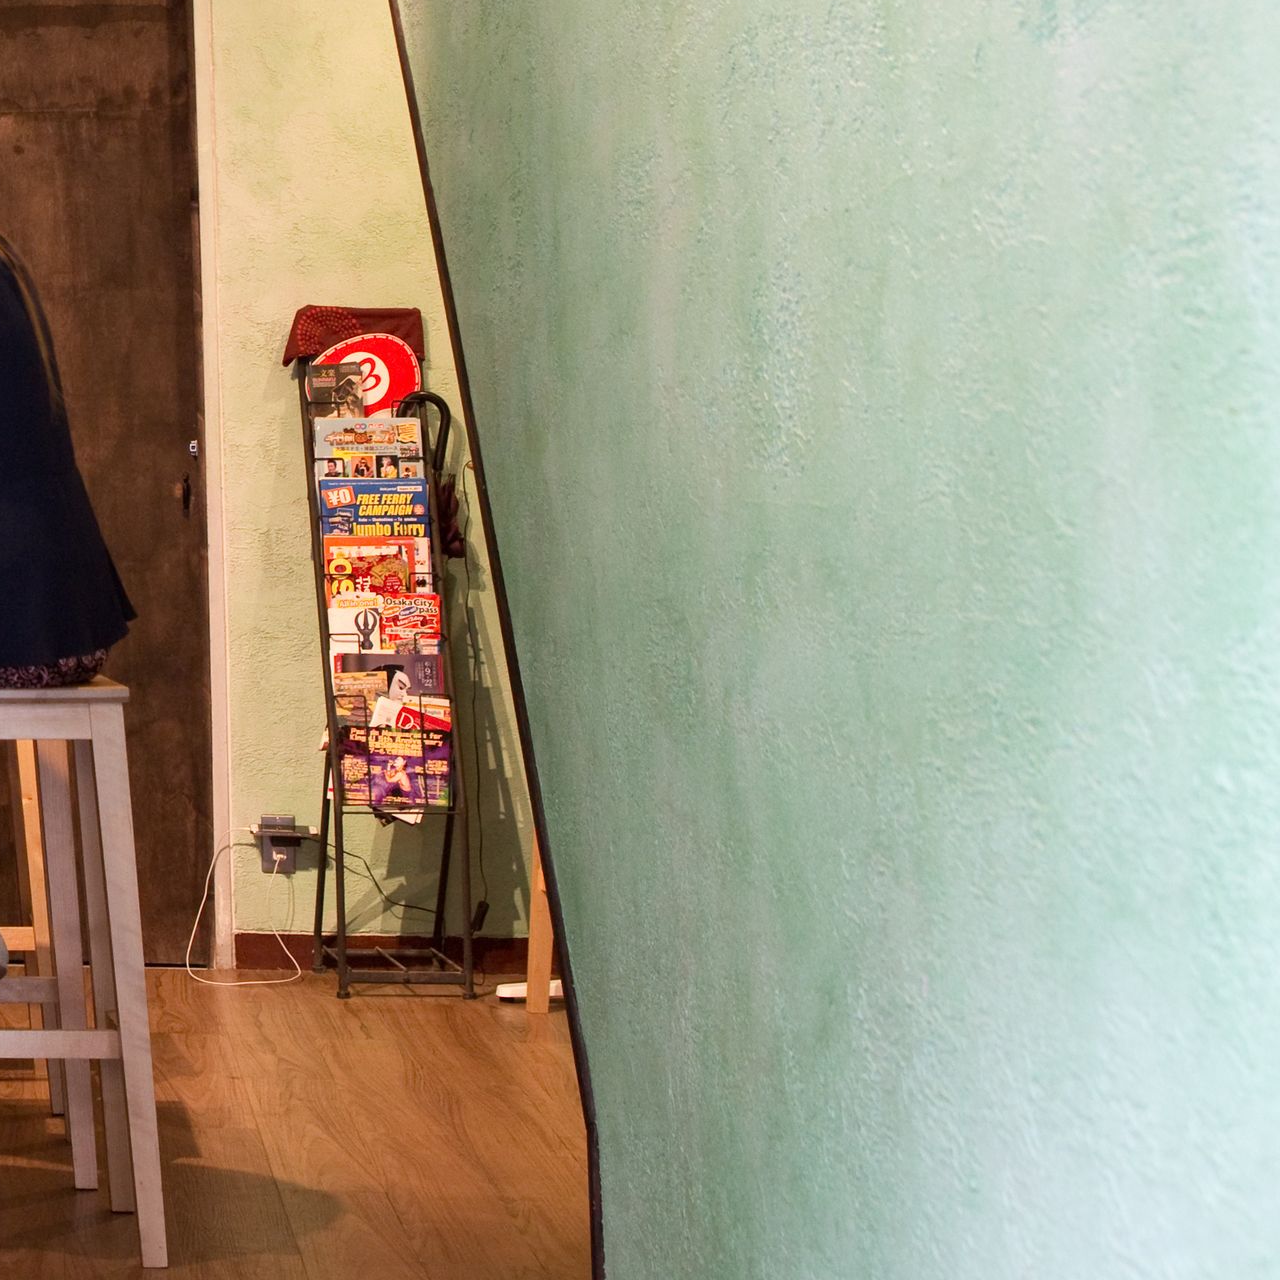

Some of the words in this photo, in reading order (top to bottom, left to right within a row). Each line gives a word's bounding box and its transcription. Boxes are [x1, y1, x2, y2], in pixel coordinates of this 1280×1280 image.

[327, 488, 352, 506] ¥0
[356, 493, 381, 505] FREE
[381, 493, 414, 505] FERRY
[358, 504, 414, 516] CAMPAIGN
[385, 597, 413, 606] Osaka
[414, 598, 434, 608] City
[419, 606, 438, 615] pass
